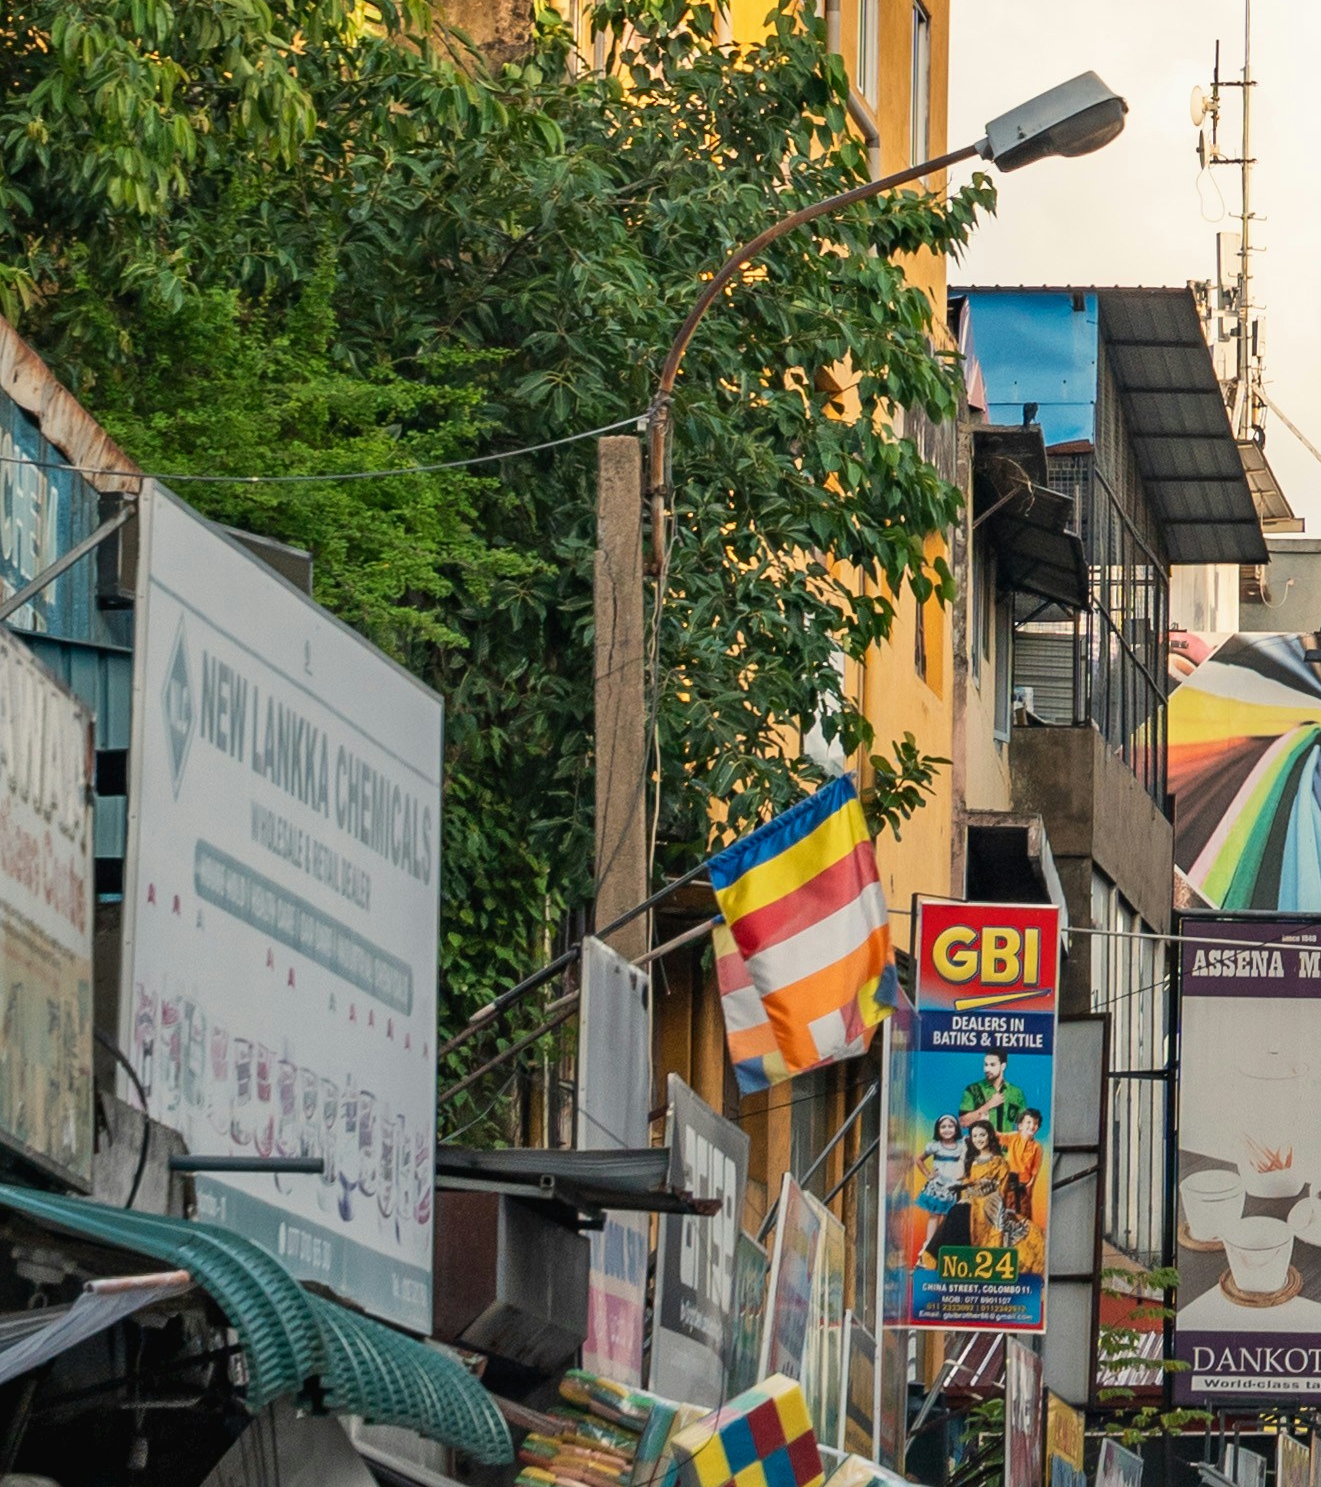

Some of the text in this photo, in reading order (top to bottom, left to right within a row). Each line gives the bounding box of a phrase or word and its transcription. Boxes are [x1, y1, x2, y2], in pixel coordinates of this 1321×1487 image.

[200, 649, 247, 762] NEW
[252, 685, 329, 818] LANKKA
[335, 744, 432, 886] CHEMICALS
[932, 925, 1040, 987] GBI
[1192, 949, 1285, 978] ASSENA
[952, 1016, 1024, 1032] DEALERS IN
[933, 1031, 1043, 1048] BATIKS & TEXTILE
[922, 1282, 947, 1292] CHINA
[1204, 1379, 1300, 1390] World-class
